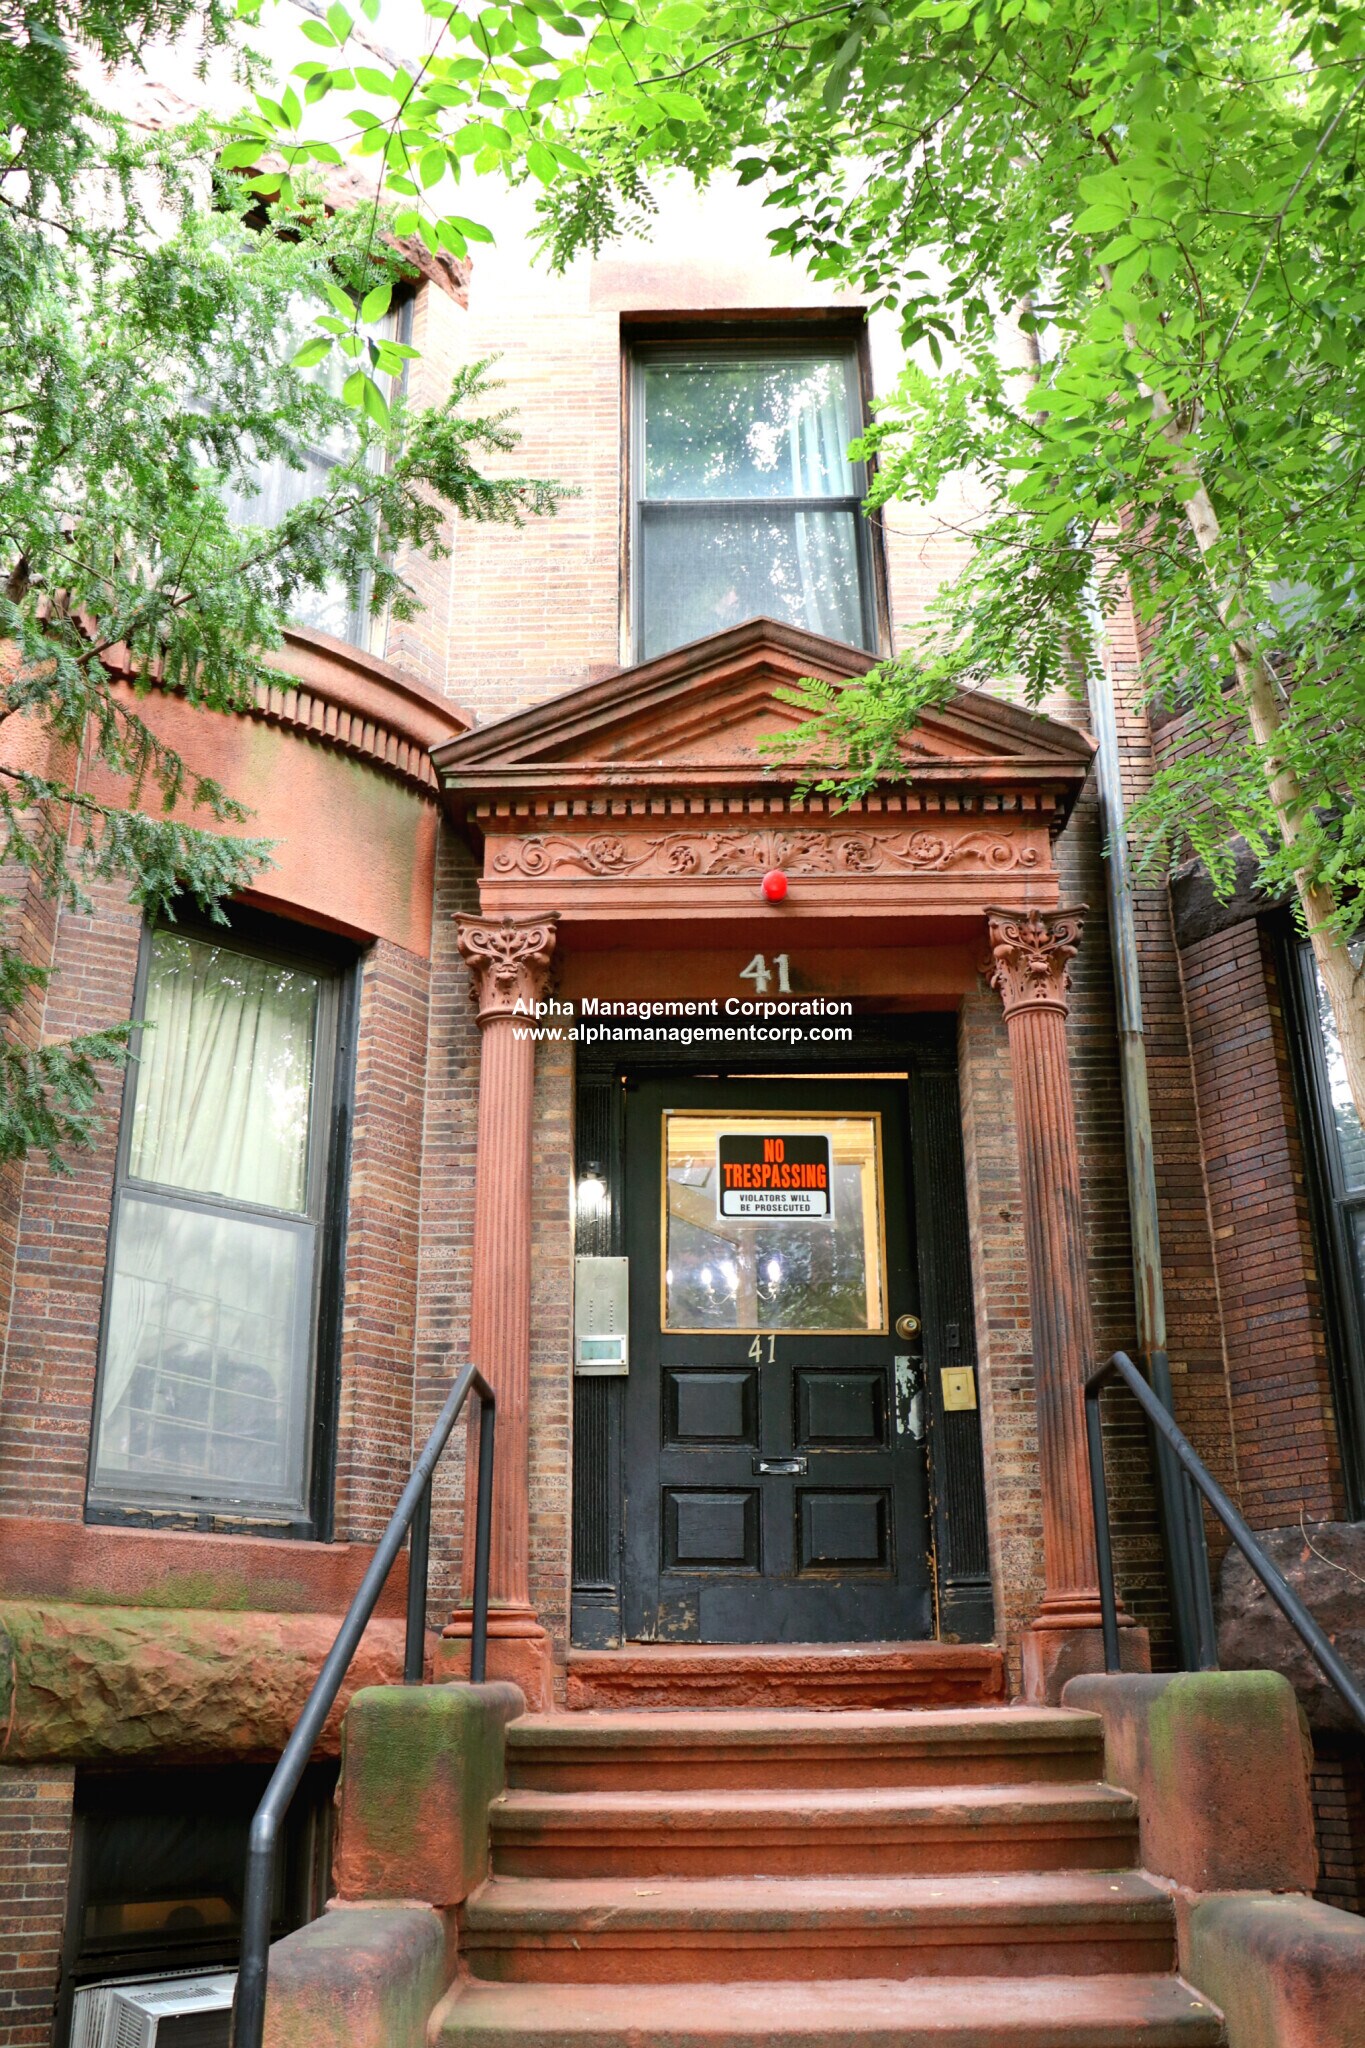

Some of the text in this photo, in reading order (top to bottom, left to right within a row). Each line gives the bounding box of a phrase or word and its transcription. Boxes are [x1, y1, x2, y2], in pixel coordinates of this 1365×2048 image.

[739, 953, 793, 994] 41
[764, 1139, 784, 1162] NO
[723, 1163, 827, 1188] TRESPASSING
[739, 1194, 811, 1202] VIOLATORS WILL
[740, 1204, 811, 1212] BE PROSECUTED
[748, 1334, 775, 1363] 41
